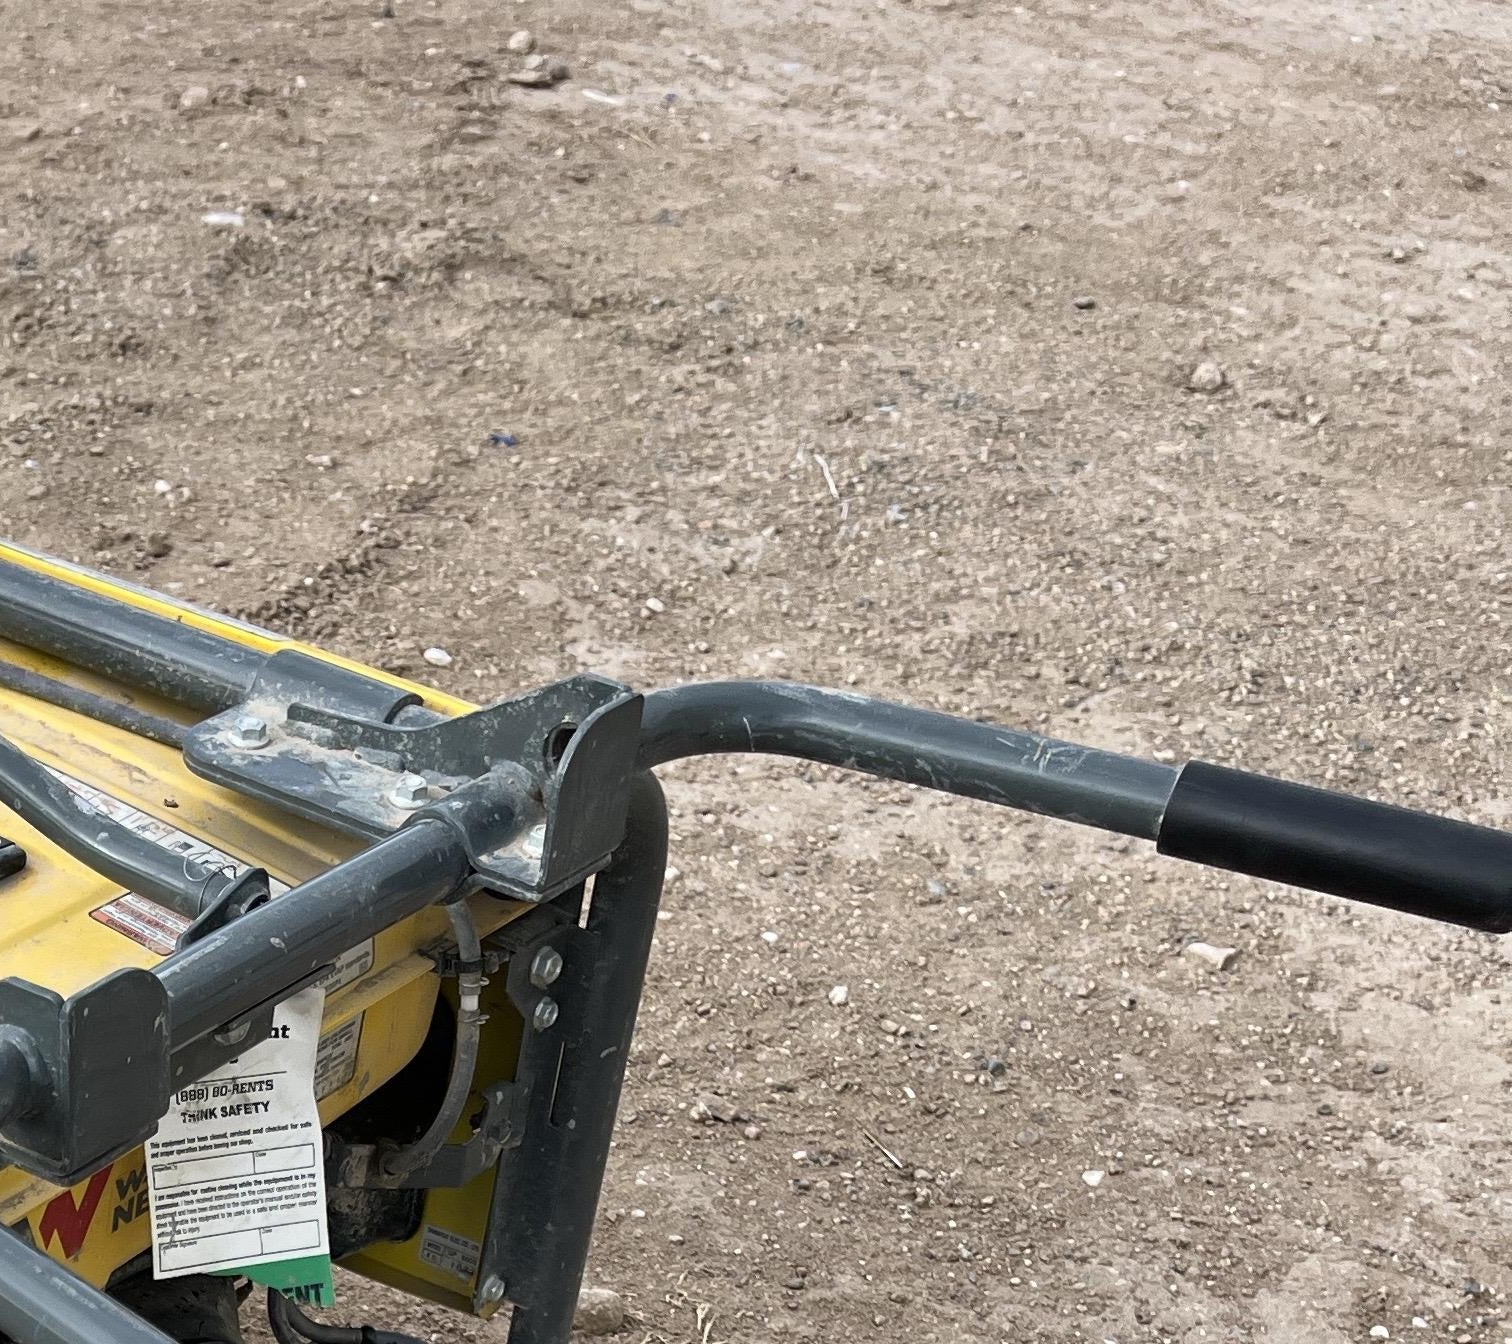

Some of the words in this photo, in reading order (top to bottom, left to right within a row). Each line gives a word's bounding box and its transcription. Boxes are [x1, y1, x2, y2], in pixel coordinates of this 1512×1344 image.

[176, 1088, 209, 1105] (888)
[180, 1107, 218, 1124] THINK
[220, 1101, 270, 1118] SAFETY
